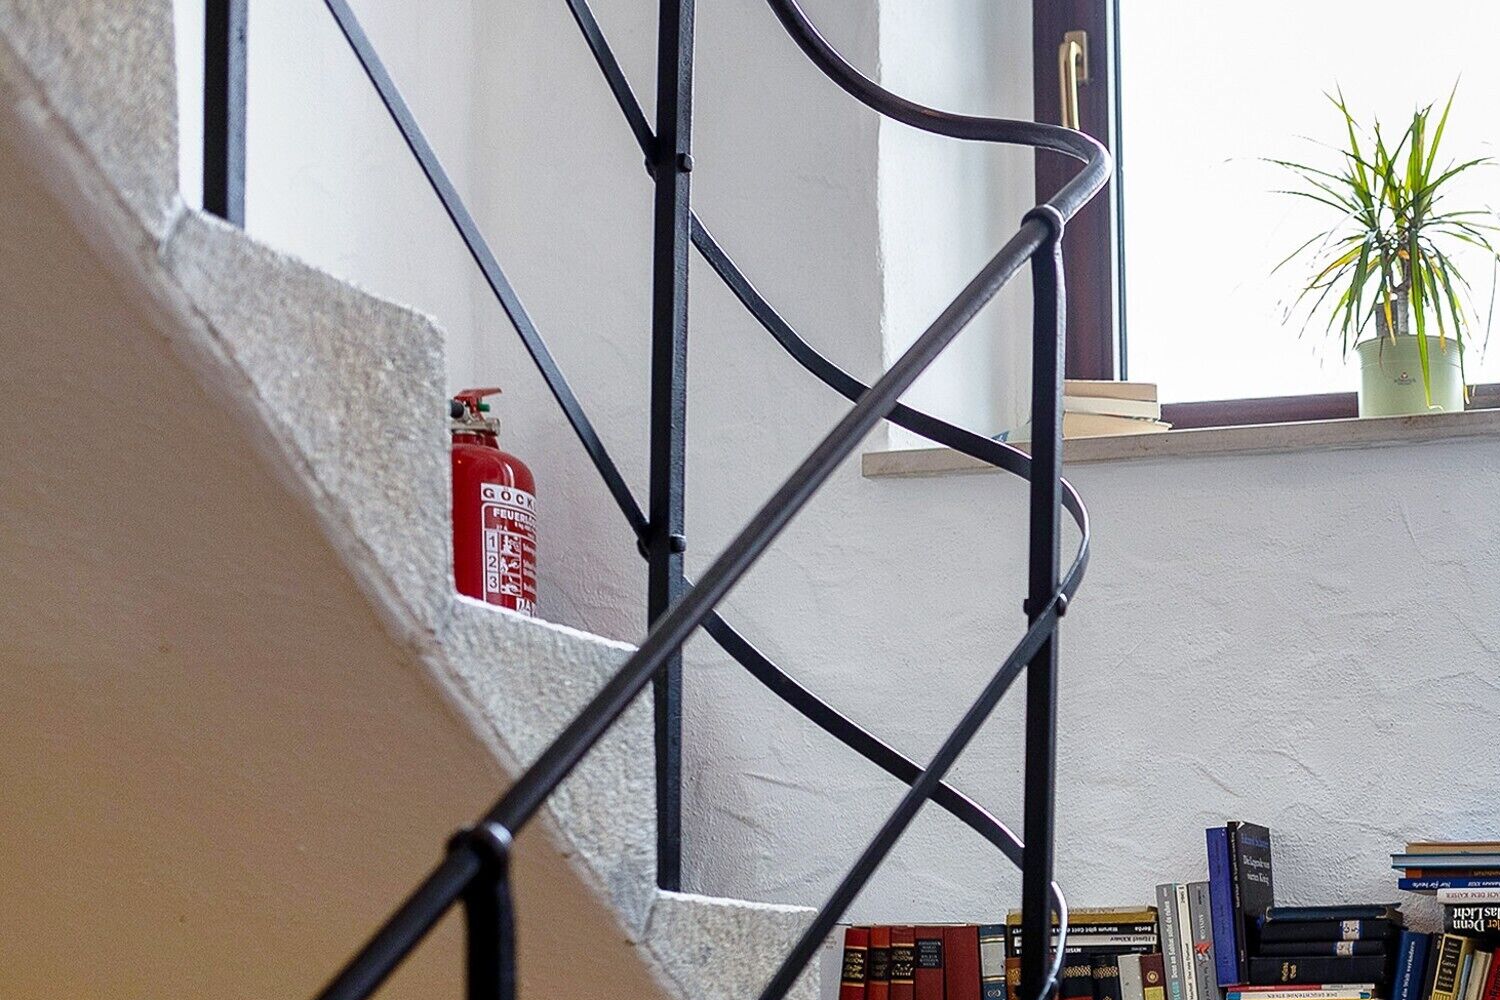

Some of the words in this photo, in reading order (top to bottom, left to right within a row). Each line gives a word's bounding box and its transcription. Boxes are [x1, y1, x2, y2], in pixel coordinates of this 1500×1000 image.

[489, 536, 495, 548] 1
[489, 556, 496, 569] 2
[489, 576, 497, 589] 3
[1453, 907, 1483, 919] Licht
[1453, 919, 1485, 931] Denn
[1402, 973, 1410, 987] Welt
